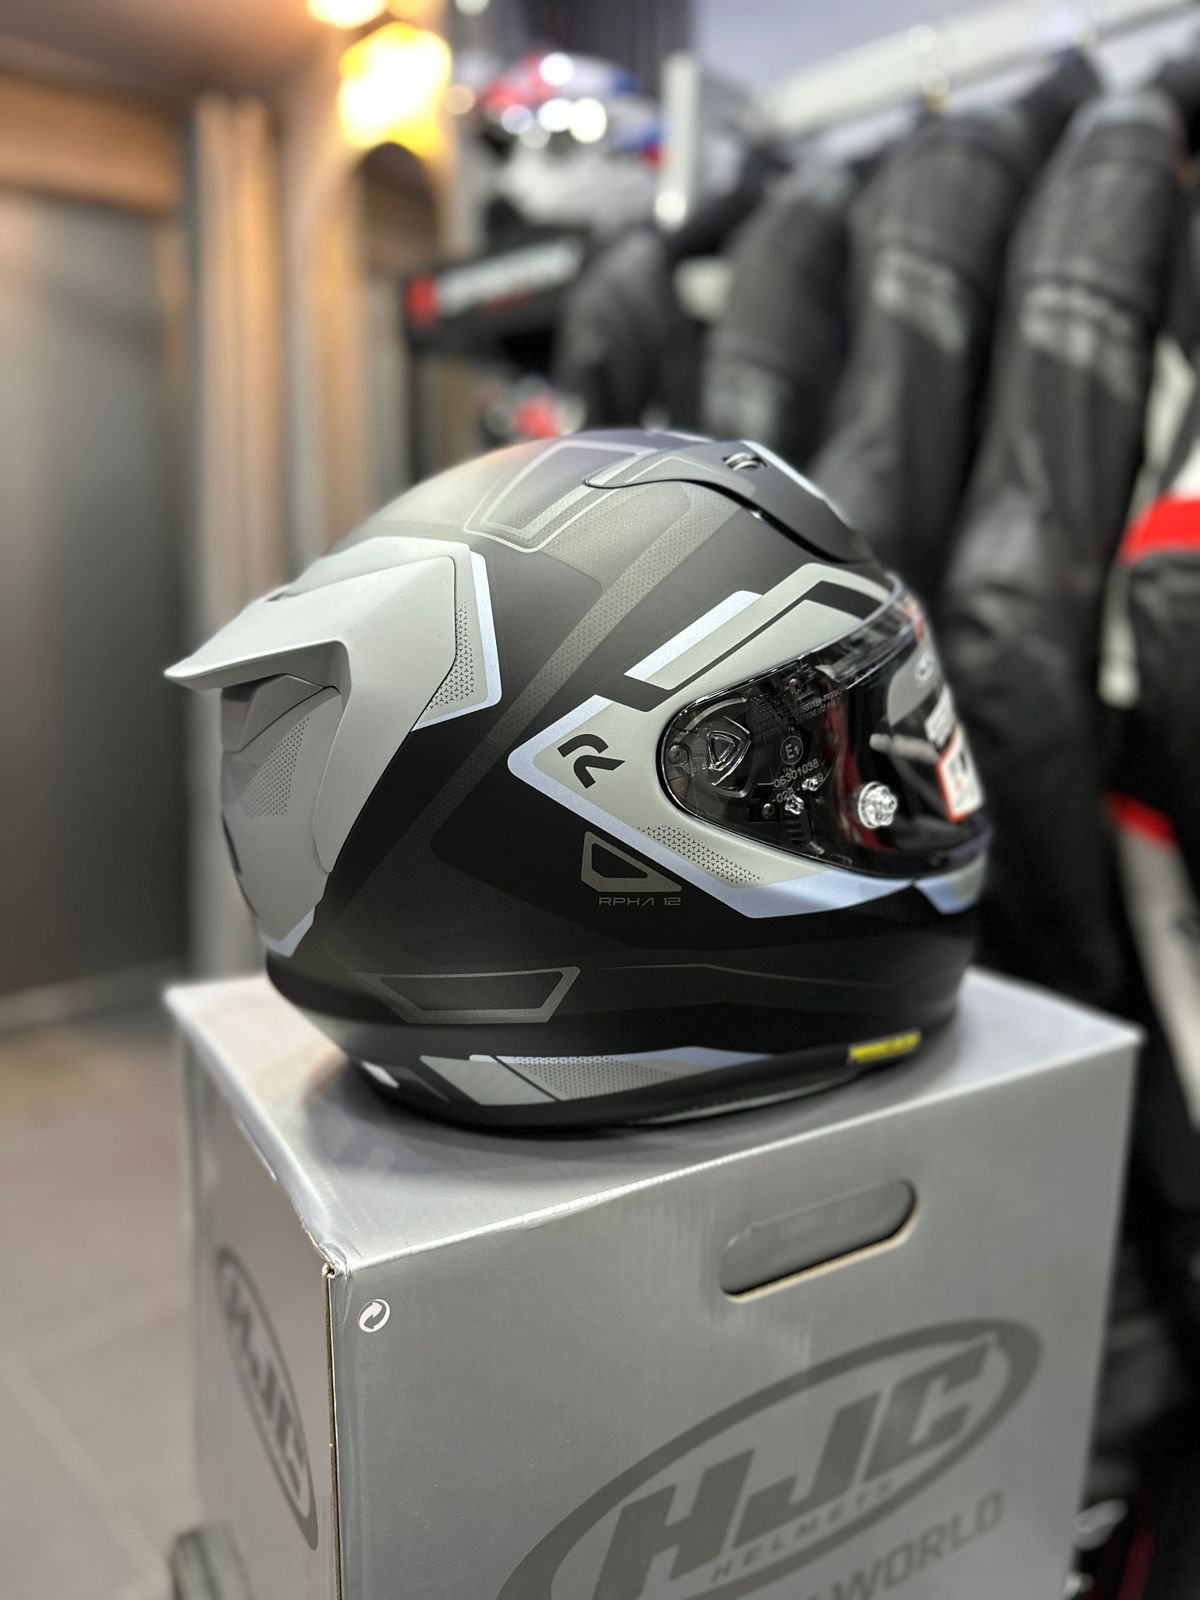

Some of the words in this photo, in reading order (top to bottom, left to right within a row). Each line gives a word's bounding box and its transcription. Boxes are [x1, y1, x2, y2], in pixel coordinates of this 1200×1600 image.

[598, 896, 655, 907] RPHA
[663, 896, 682, 907] 12
[591, 1339, 991, 1600] HJC
[711, 1480, 892, 1584] HELMETS
